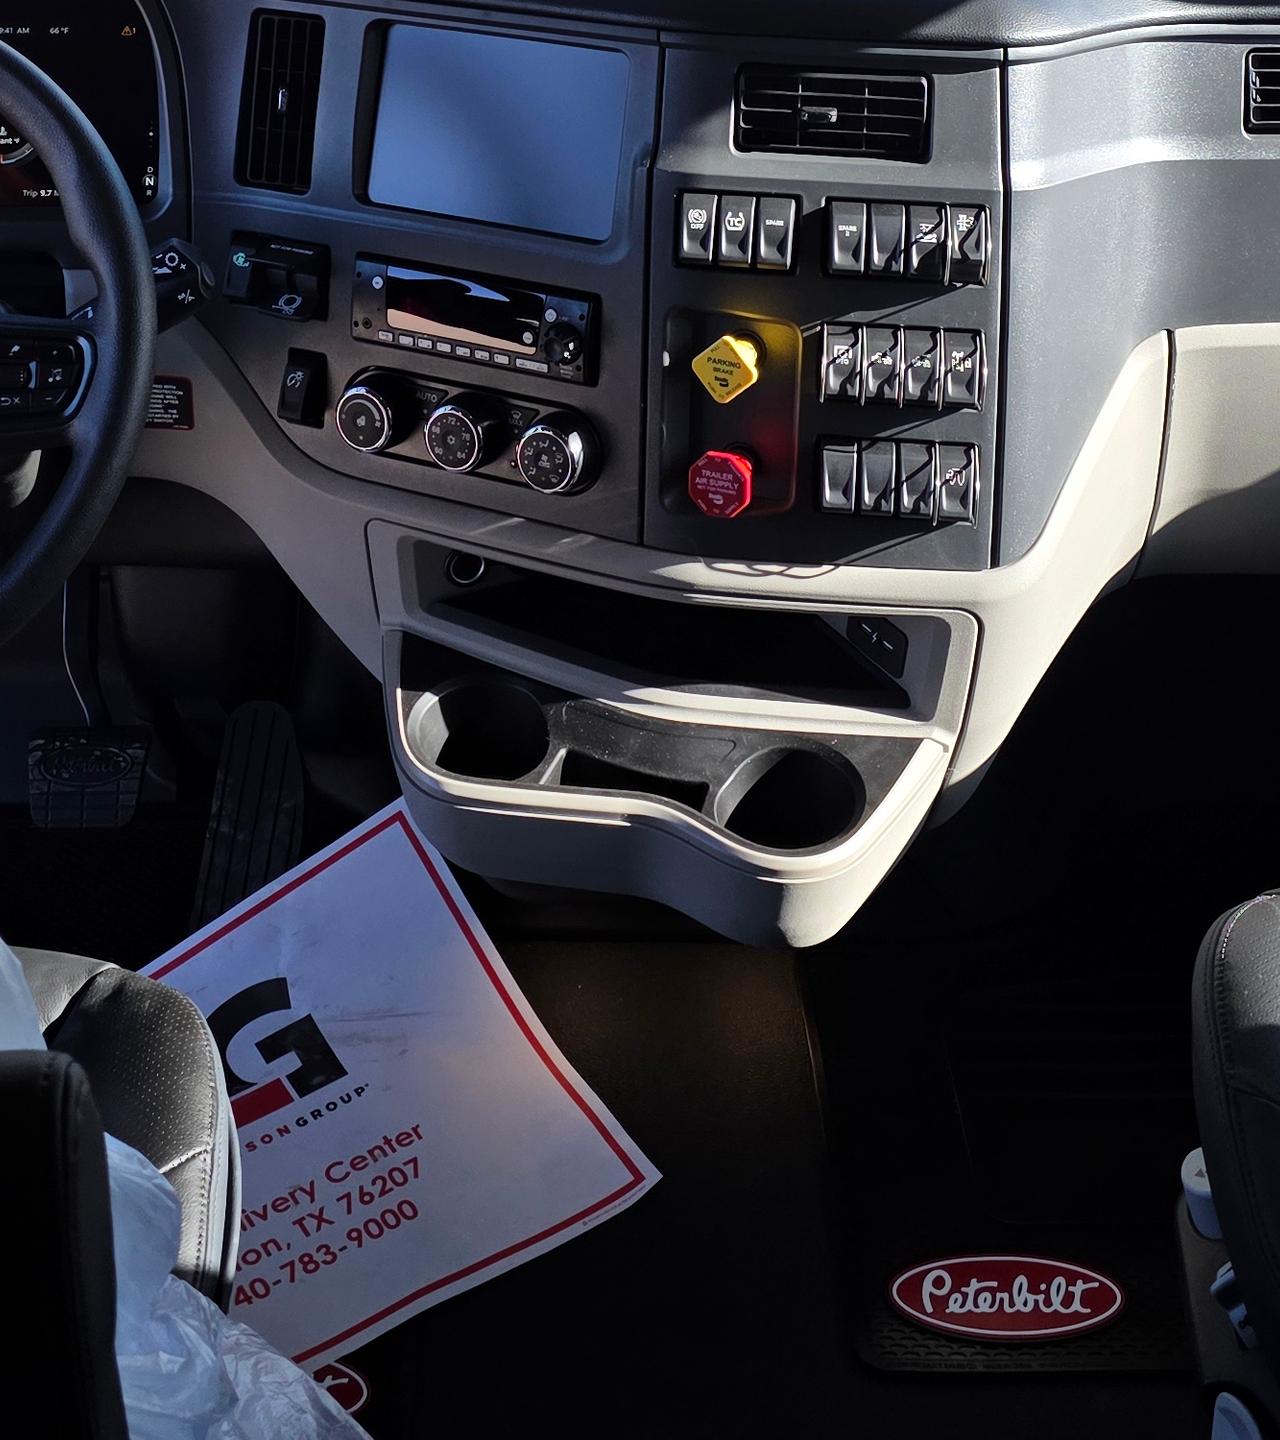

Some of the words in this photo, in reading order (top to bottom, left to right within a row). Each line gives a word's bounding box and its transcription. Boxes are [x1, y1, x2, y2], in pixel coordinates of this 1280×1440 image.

[16, 27, 30, 35] AM
[145, 176, 154, 187] N
[22, 189, 38, 198] Trip
[39, 189, 53, 197] 9.7
[728, 217, 742, 226] TC
[706, 356, 741, 370] PARKING
[712, 367, 733, 376] BRAKE
[416, 391, 438, 403] AUTO
[447, 417, 456, 425] 72
[701, 469, 733, 481] TRAILER
[695, 477, 708, 485] AIR
[709, 478, 739, 490] SUPPLY
[244, 1124, 292, 1153] SON
[324, 1124, 424, 1184] Center
[291, 1205, 336, 1238] TX
[335, 1156, 420, 1216] 76207
[233, 1199, 420, 1307] 40-783-9000
[921, 1268, 1100, 1314] Peterbilt
